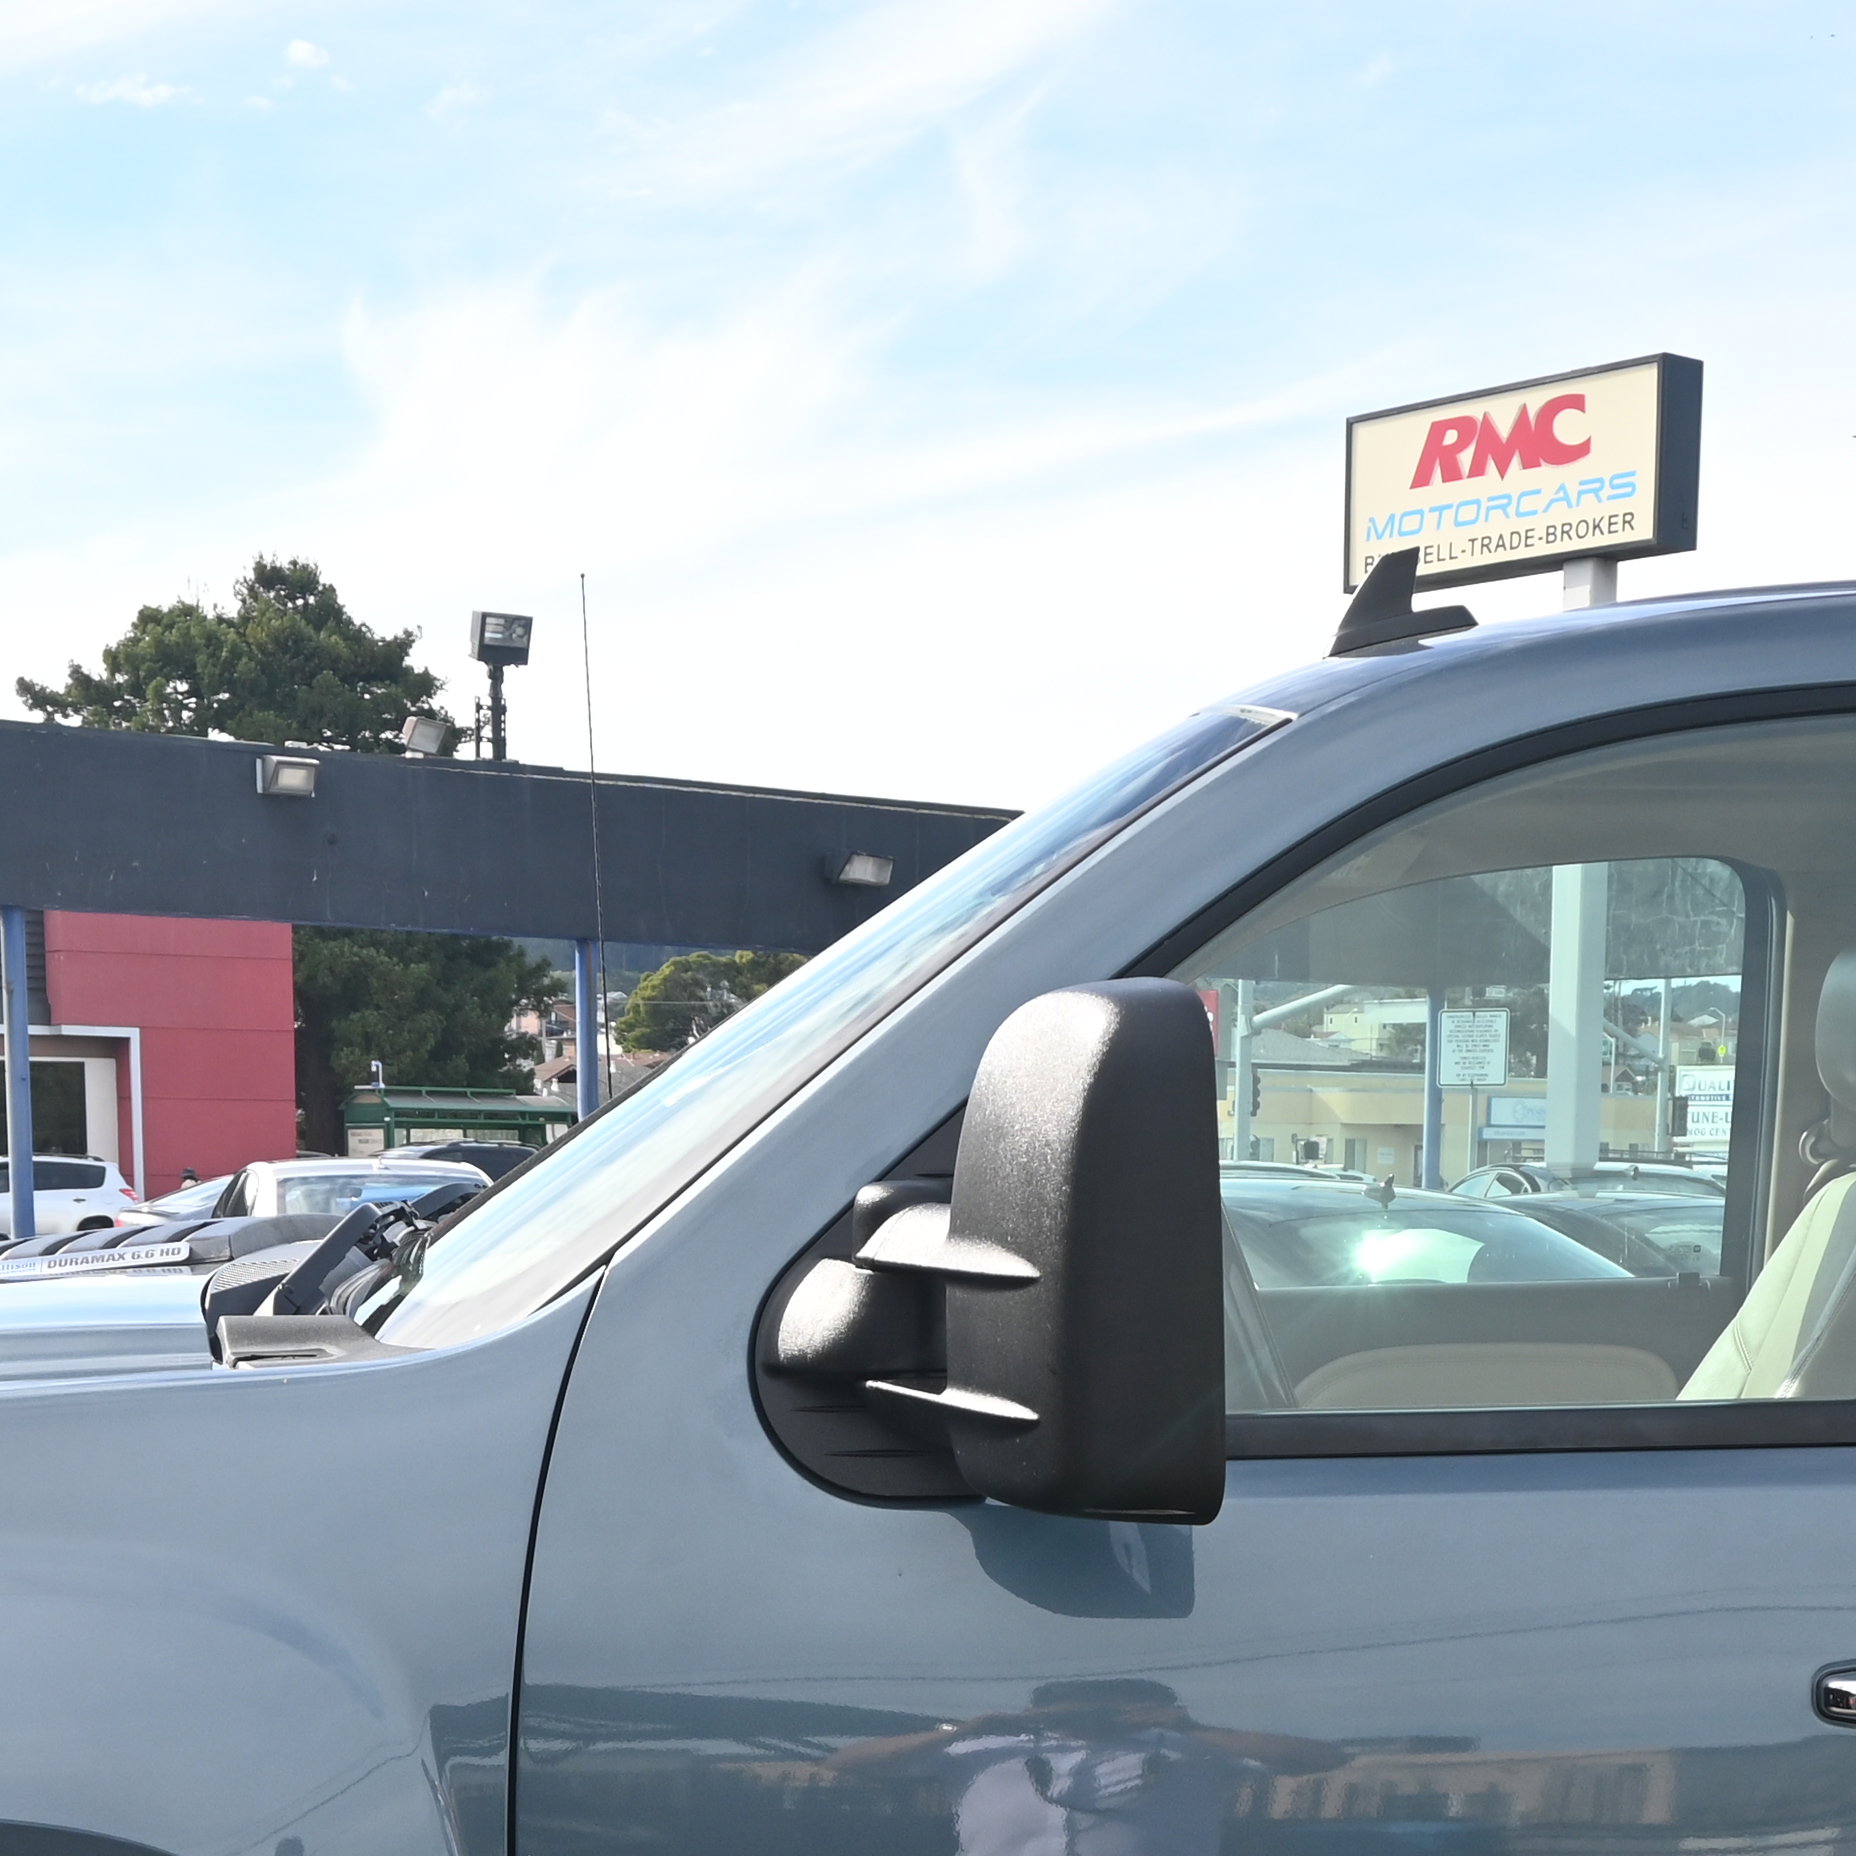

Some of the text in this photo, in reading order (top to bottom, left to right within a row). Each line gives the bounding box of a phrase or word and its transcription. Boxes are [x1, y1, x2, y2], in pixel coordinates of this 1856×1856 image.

[1409, 393, 1592, 490] RMC
[1365, 469, 1638, 542] MOTORCARS
[1681, 1073, 1731, 1092] QUALI
[47, 1251, 127, 1270] DURAMAX
[131, 1248, 156, 1261] 6.6
[159, 1245, 182, 1258] HD
